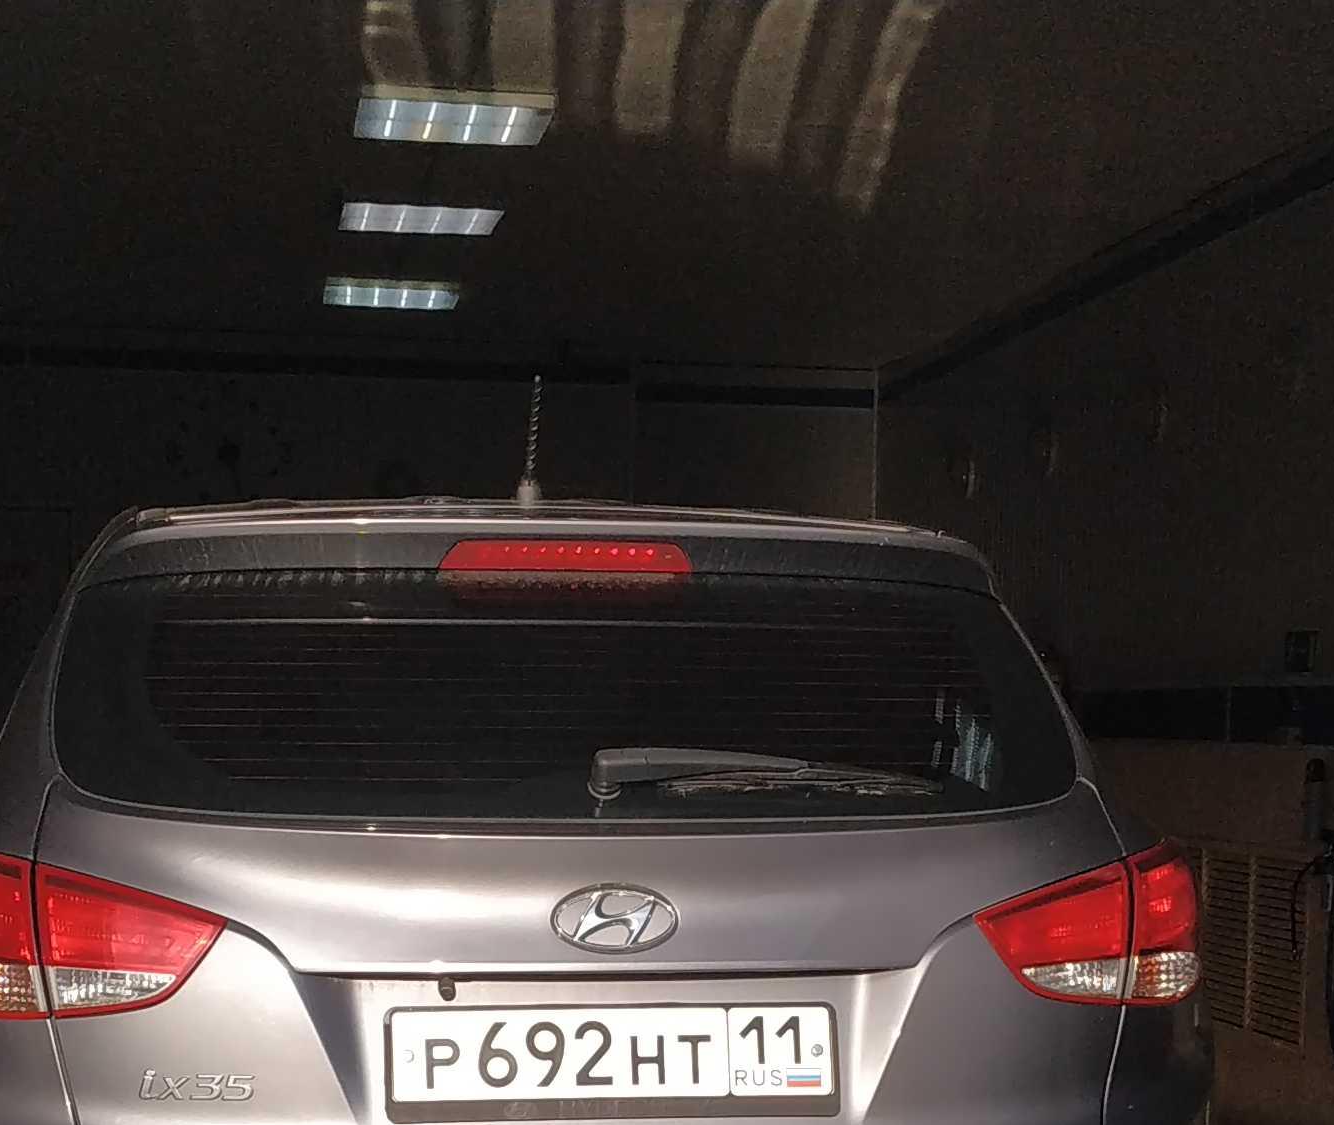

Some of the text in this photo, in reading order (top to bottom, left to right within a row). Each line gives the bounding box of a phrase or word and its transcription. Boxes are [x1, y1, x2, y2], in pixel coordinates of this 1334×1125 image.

[424, 1015, 802, 1090] Р692НТ 11
[138, 1069, 256, 1101] ix35
[734, 1069, 784, 1087] RUS
